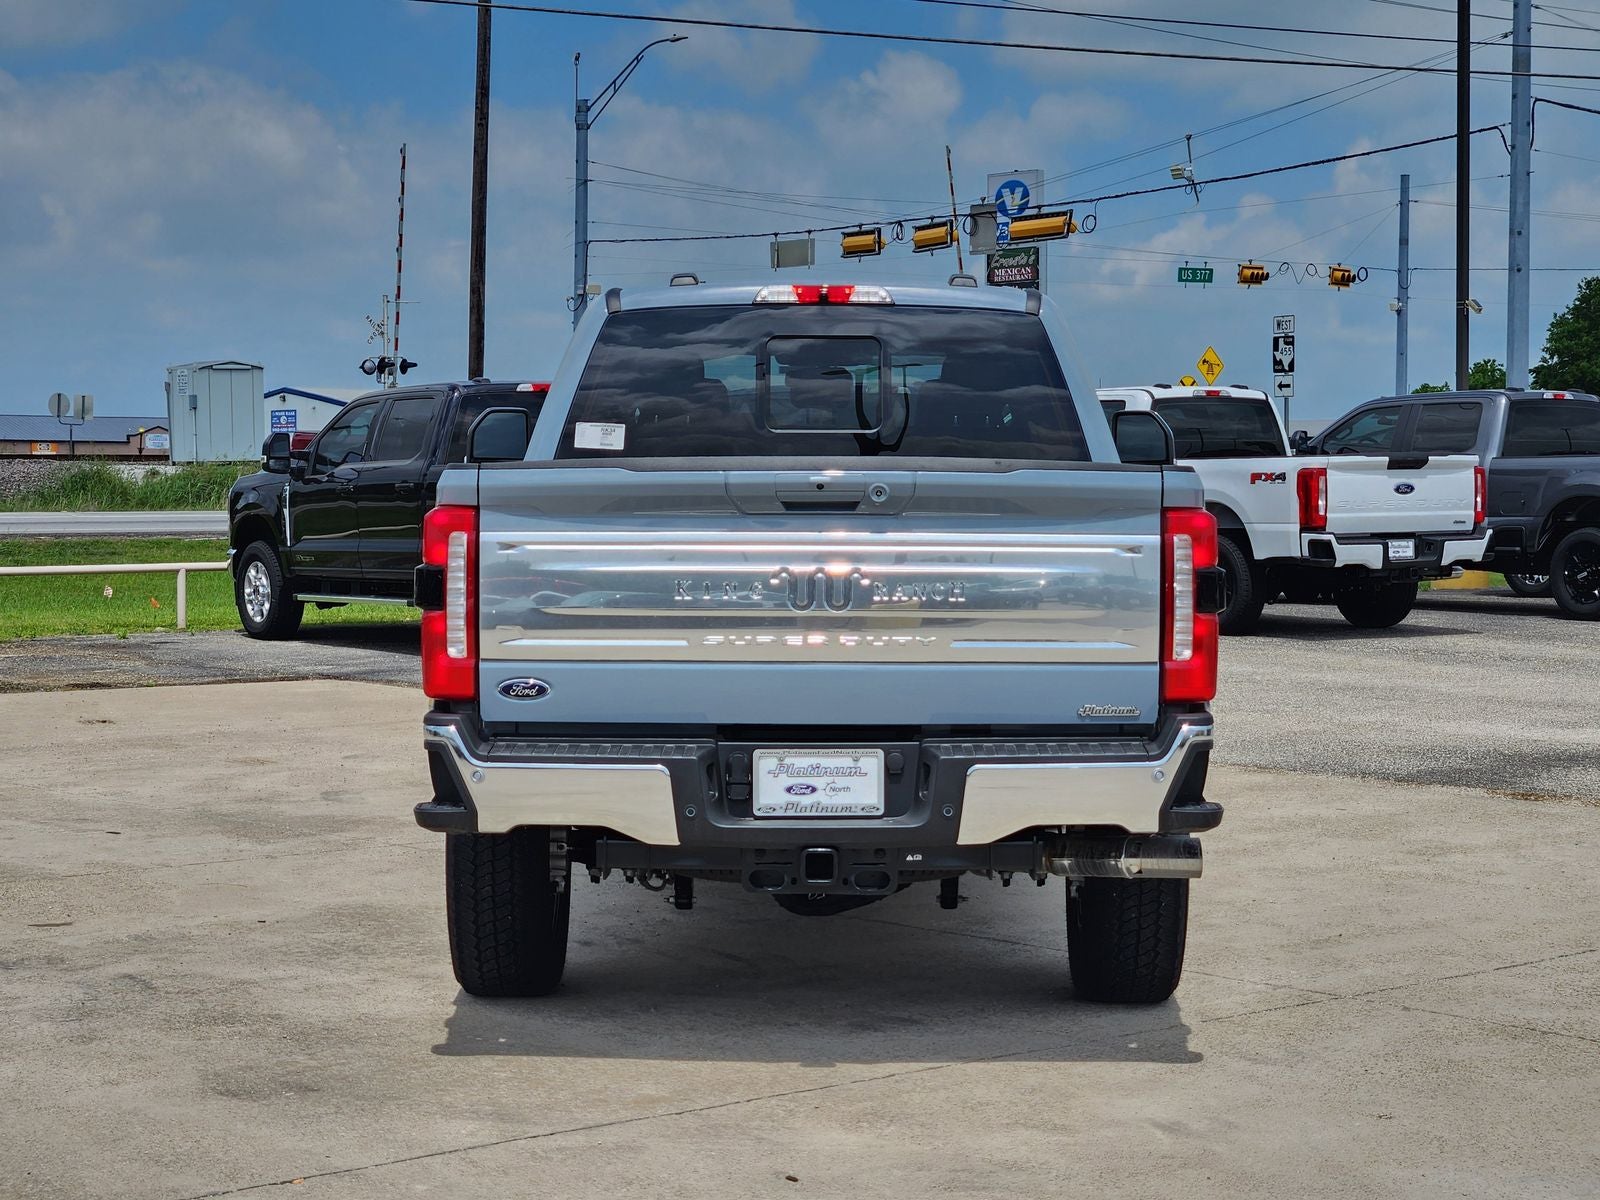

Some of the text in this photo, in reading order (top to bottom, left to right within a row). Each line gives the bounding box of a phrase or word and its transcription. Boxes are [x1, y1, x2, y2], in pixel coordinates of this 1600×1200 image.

[994, 266, 1032, 277] MEXICAN
[994, 273, 1032, 282] RESTAURANT
[1181, 269, 1210, 280] US 377
[1276, 319, 1292, 331] WEST
[1280, 346, 1293, 356] 455
[1249, 472, 1287, 484] FX4
[673, 579, 967, 602] KING RANCH
[702, 634, 828, 646] SUPER
[509, 683, 539, 696] Ford
[1078, 703, 1141, 717] Platinum
[767, 763, 868, 778] Platinum
[790, 784, 813, 794] Ford
[783, 802, 857, 814] Platinum
